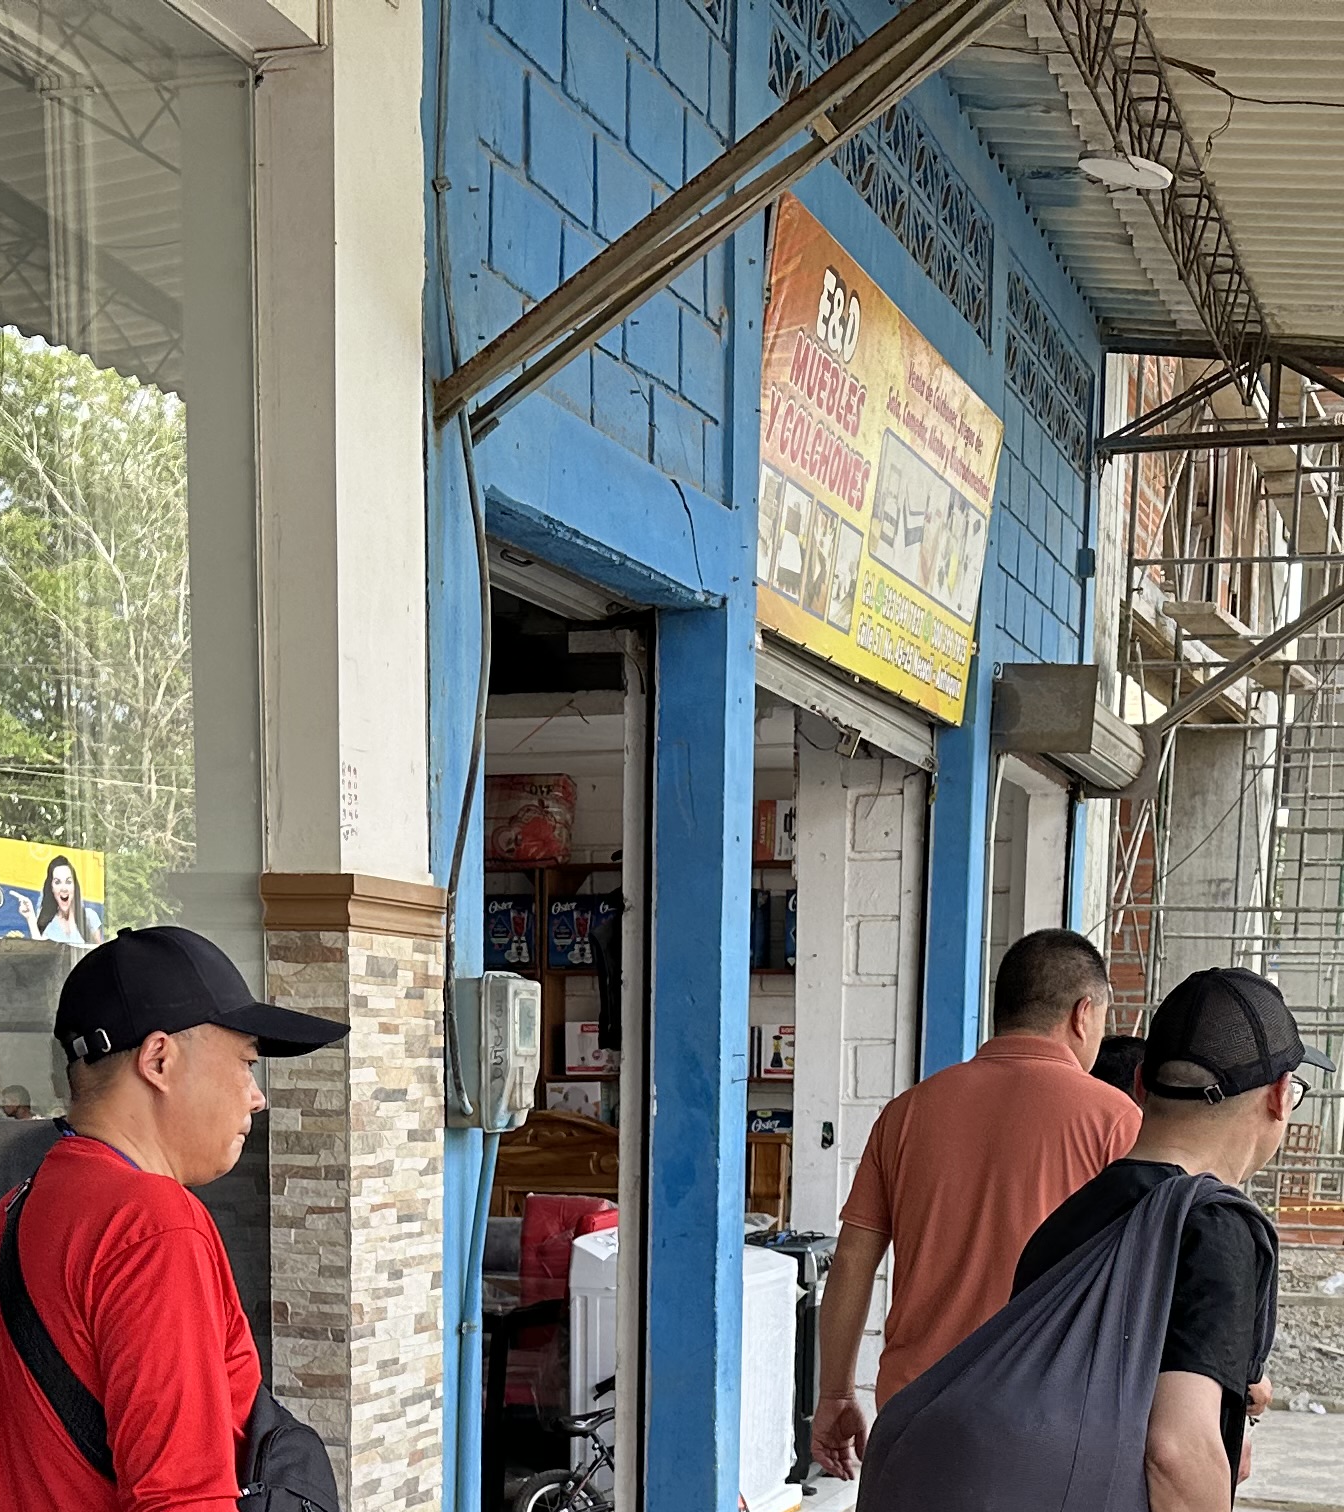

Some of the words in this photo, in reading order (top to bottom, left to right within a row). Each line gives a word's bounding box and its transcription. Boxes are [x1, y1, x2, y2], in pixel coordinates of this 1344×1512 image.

[816, 267, 861, 364] E&D
[789, 330, 867, 438] MUEBLES
[765, 385, 783, 445] Y
[779, 399, 872, 512] COLCHONES
[488, 900, 514, 914] Oster
[551, 900, 577, 915] Oster
[751, 1118, 781, 1132] Oster
